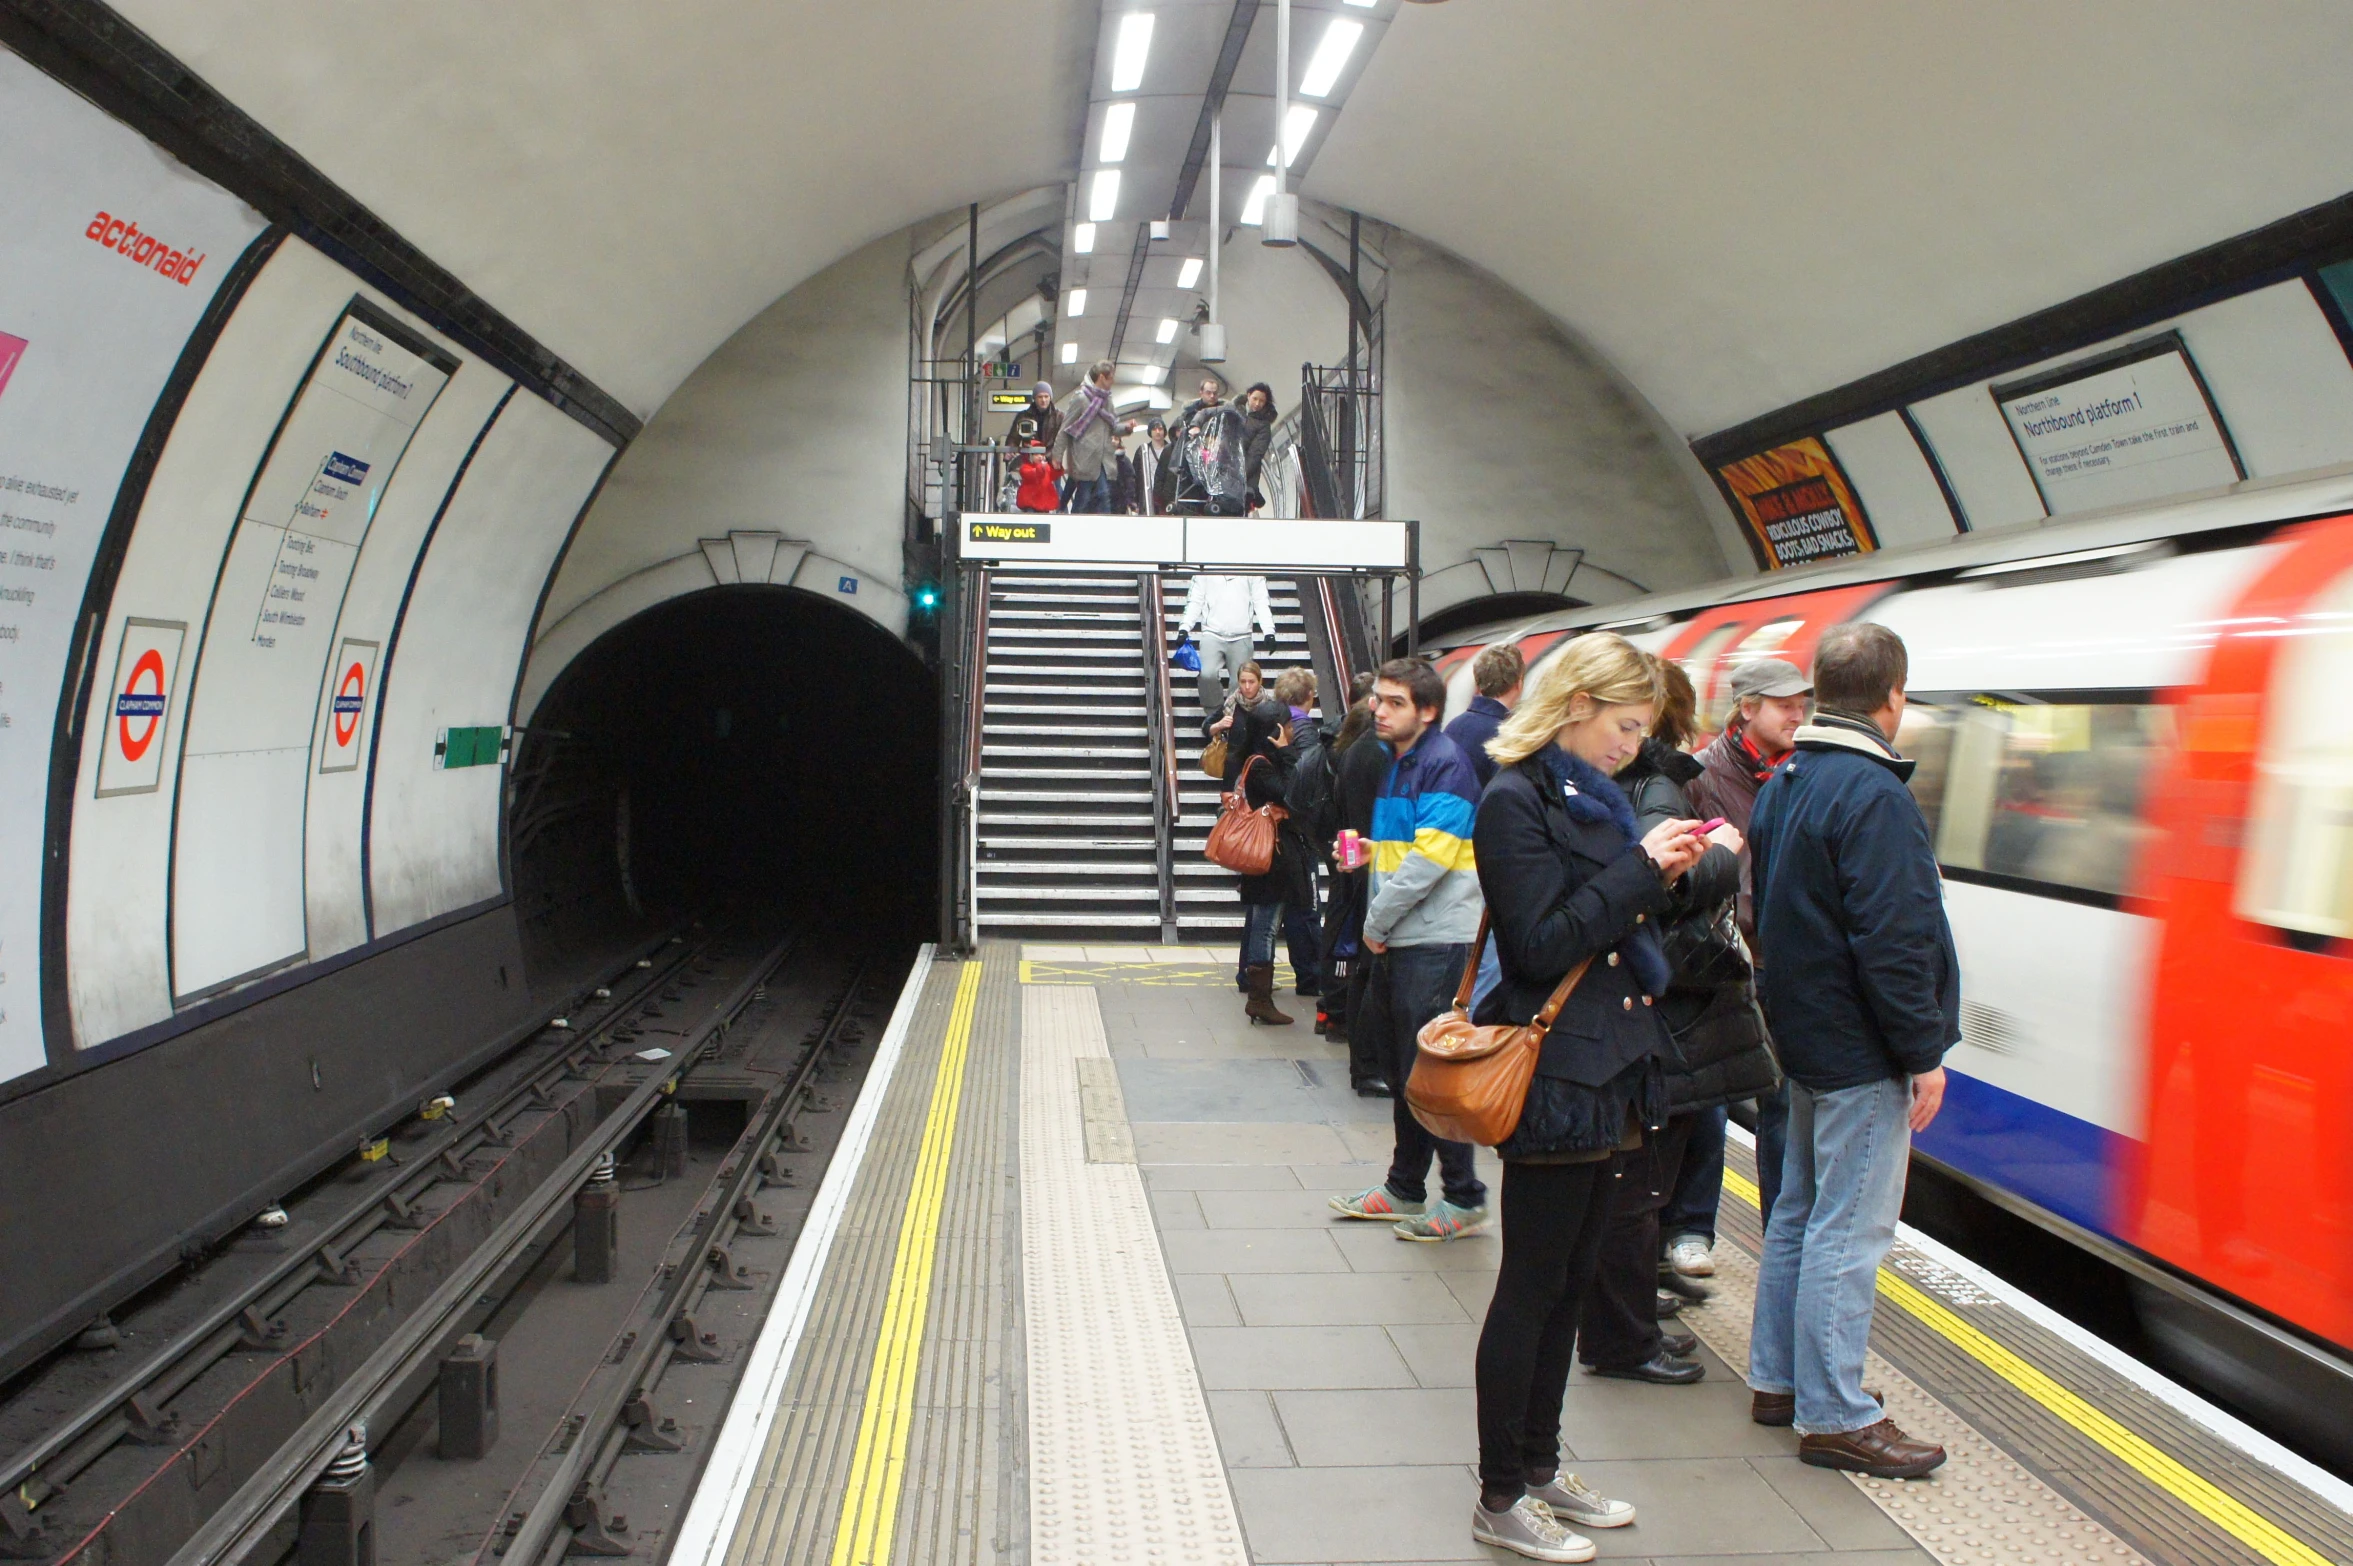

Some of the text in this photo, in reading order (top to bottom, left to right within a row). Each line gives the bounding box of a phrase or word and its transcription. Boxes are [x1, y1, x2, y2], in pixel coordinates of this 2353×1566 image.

[336, 346, 383, 384] Southbound
[376, 371, 408, 397] platform
[1000, 395, 1014, 404] Way
[2014, 396, 2061, 416] Northern line
[2023, 391, 2142, 438] Northbound platform 1
[2039, 420, 2199, 466] For stations beyond Camden Town take the first train and
[25, 481, 68, 502] exhausted
[13, 516, 57, 540] community
[985, 525, 1036, 541] Way out
[1766, 508, 1844, 541] RIDICULOUS COWBOY
[1800, 535, 1820, 556] BAD
[1817, 528, 1856, 552] SNACKS,
[843, 580, 853, 592] A
